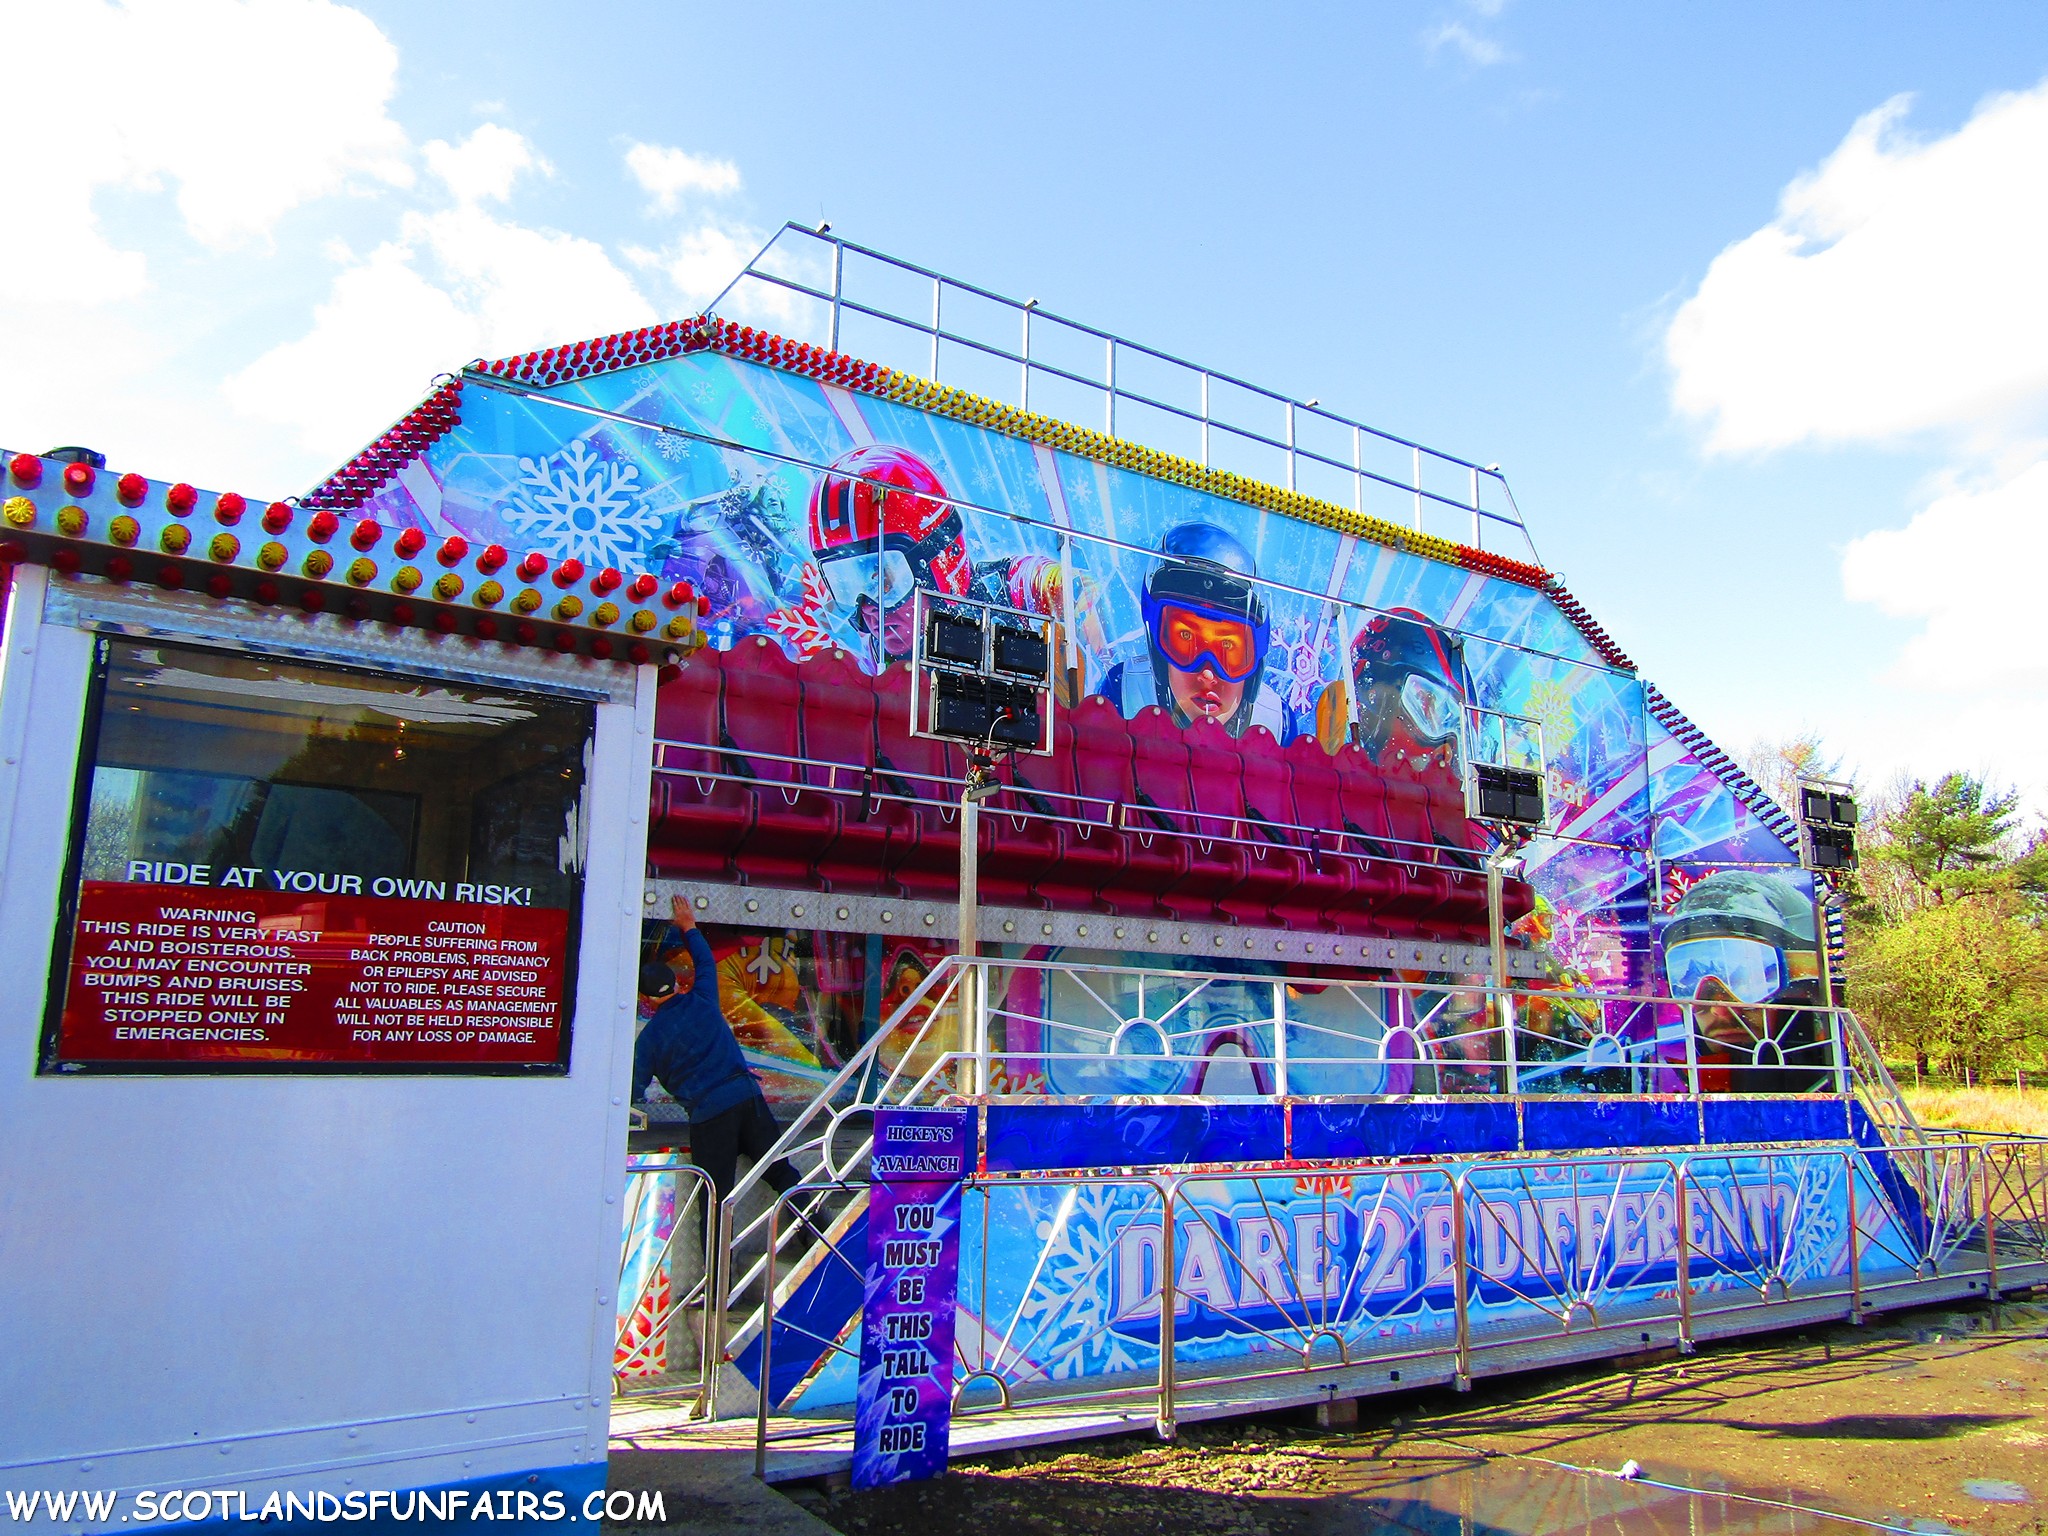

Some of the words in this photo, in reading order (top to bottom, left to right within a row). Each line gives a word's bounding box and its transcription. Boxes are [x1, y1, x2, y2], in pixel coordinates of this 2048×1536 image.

[128, 860, 211, 886] RIDE
[221, 866, 262, 888] AT
[273, 870, 363, 895] YOUR
[372, 877, 447, 900] OWN
[455, 883, 532, 906] RISK!
[160, 907, 256, 924] WARNING
[81, 920, 131, 935] THIS
[137, 923, 186, 938] RIDE
[192, 925, 211, 939] IS
[218, 927, 271, 941] VERY
[275, 929, 323, 943] FAST
[428, 921, 486, 934] CAUTION
[107, 939, 154, 953] AND
[160, 941, 296, 959] BOISTEROUS.
[369, 934, 421, 948] PEOPLE
[424, 936, 497, 951] SUFFERING
[501, 940, 538, 952] FROM
[86, 955, 131, 970] YOU
[137, 957, 181, 971] MAY
[187, 959, 312, 975] ENCOUNTER
[350, 949, 389, 962] BACK
[393, 951, 470, 966] PROBLEMS,
[474, 954, 550, 968] PREGNANCY
[84, 973, 162, 988] BUMPS
[167, 976, 213, 989] AND
[218, 977, 308, 992] BRUISES.
[363, 966, 383, 977] OR
[387, 967, 449, 980] EPILEPSY
[452, 968, 479, 981] ARE
[482, 969, 538, 982] ADVISED
[350, 981, 379, 993] NOT
[383, 983, 402, 994] TO
[405, 983, 440, 995] RIDE.
[444, 984, 493, 997] PLEASE
[496, 985, 546, 998] SECURE
[101, 991, 149, 1005] THIS
[156, 993, 205, 1006] RIDE
[211, 994, 259, 1007] WILL
[265, 995, 291, 1008] BE
[334, 997, 361, 1009] ALL
[365, 998, 442, 1011] VALUABLES
[446, 1000, 464, 1011] AS
[467, 1000, 558, 1013] MANAGEMENT
[104, 1009, 203, 1023] STOPPED
[208, 1011, 260, 1024] ONLY
[265, 1012, 285, 1024] IN
[337, 1013, 370, 1025] WILL
[374, 1014, 404, 1025] NOT
[407, 1014, 425, 1026] BE
[429, 1015, 463, 1027] HELD
[466, 1016, 553, 1028] RESPONSIBLE
[115, 1026, 270, 1041] EMERGENCIES.
[353, 1030, 382, 1041] FOR
[384, 1030, 414, 1042] ANY
[418, 1031, 452, 1043] LOSS
[478, 1032, 536, 1043] DAMAGE.
[886, 1125, 953, 1142] HICKEY'S
[876, 1155, 960, 1172] AVALANCH
[895, 1204, 936, 1231] YOU
[884, 1240, 941, 1268] MUST
[1115, 1212, 1341, 1323] DARE
[896, 1276, 925, 1304] BE
[886, 1312, 933, 1341] THIS
[882, 1349, 931, 1379] TALL
[891, 1386, 919, 1416] TO
[878, 1422, 926, 1454] RIDE
